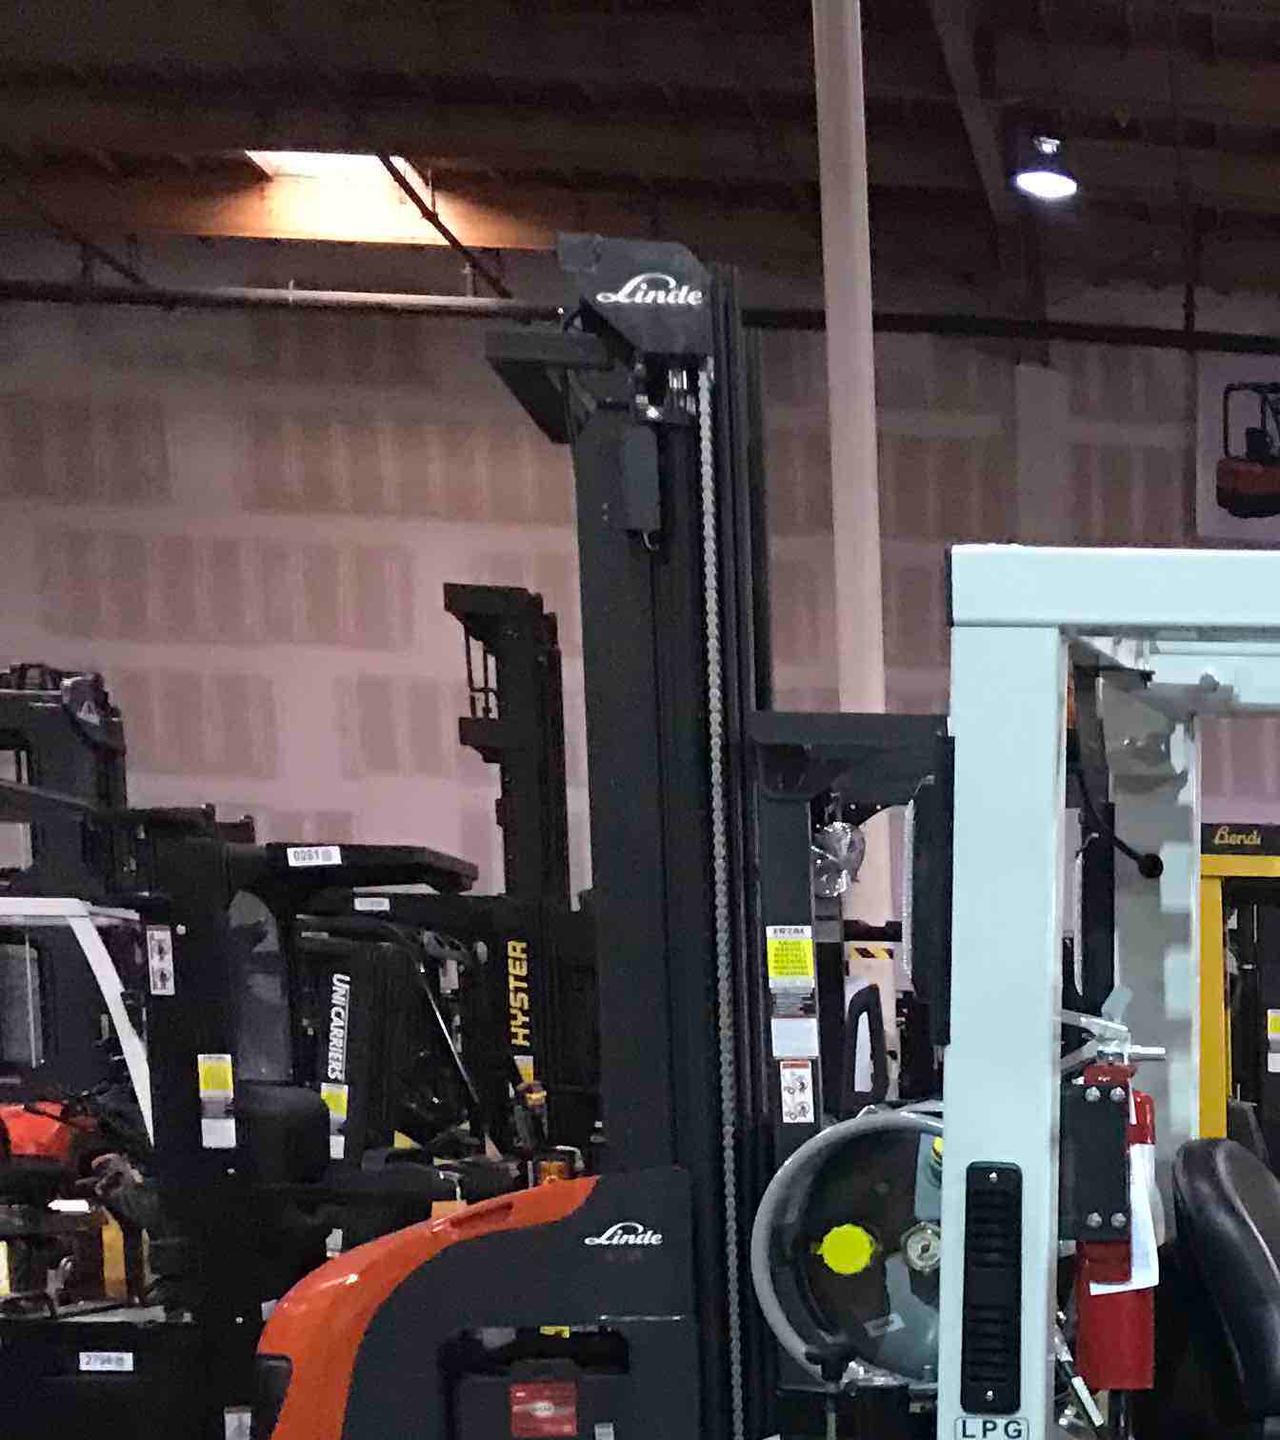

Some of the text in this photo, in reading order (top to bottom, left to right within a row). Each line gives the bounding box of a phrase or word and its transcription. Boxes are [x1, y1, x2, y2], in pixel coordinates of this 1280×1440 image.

[596, 272, 703, 305] Linde
[507, 940, 531, 1047] HYSTER
[327, 973, 350, 1081] UNICARRIERS
[584, 1222, 663, 1245] Linde
[961, 1420, 1023, 1439] LPG
